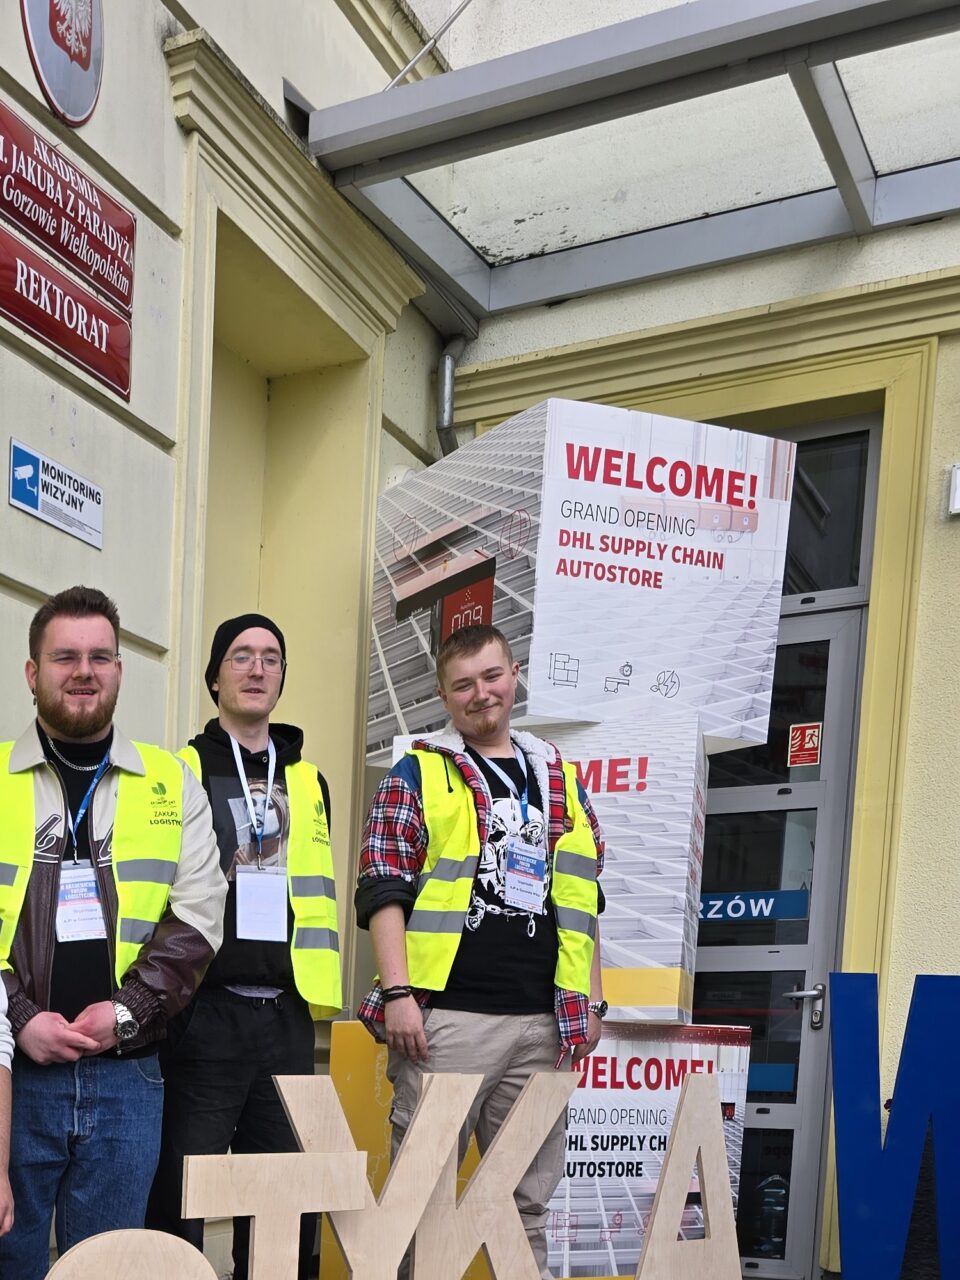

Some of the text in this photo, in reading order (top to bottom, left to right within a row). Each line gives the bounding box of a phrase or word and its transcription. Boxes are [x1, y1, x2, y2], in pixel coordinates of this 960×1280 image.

[33, 135, 102, 211] AKADEMIA
[11, 143, 63, 208] JAKUBA
[66, 190, 76, 217] Z
[78, 201, 134, 272] PARADYŻA
[3, 176, 57, 236] Gorzowie
[60, 216, 129, 296] Wielkopolskim
[15, 257, 109, 353] REKTORAT
[41, 460, 102, 505] MONITORING
[41, 479, 85, 513] WIZYJNY
[565, 443, 758, 510] WELCOME!
[560, 500, 696, 537] GRAND OPENING
[559, 529, 725, 570] DHL SUPPLY CHAIN
[556, 558, 663, 589] AUTOSTORE
[568, 1107, 668, 1126] RAND OPENING
[565, 1134, 587, 1151] HL
[590, 1134, 646, 1151] SUPPLY
[563, 1161, 644, 1178] UTOSTORE
